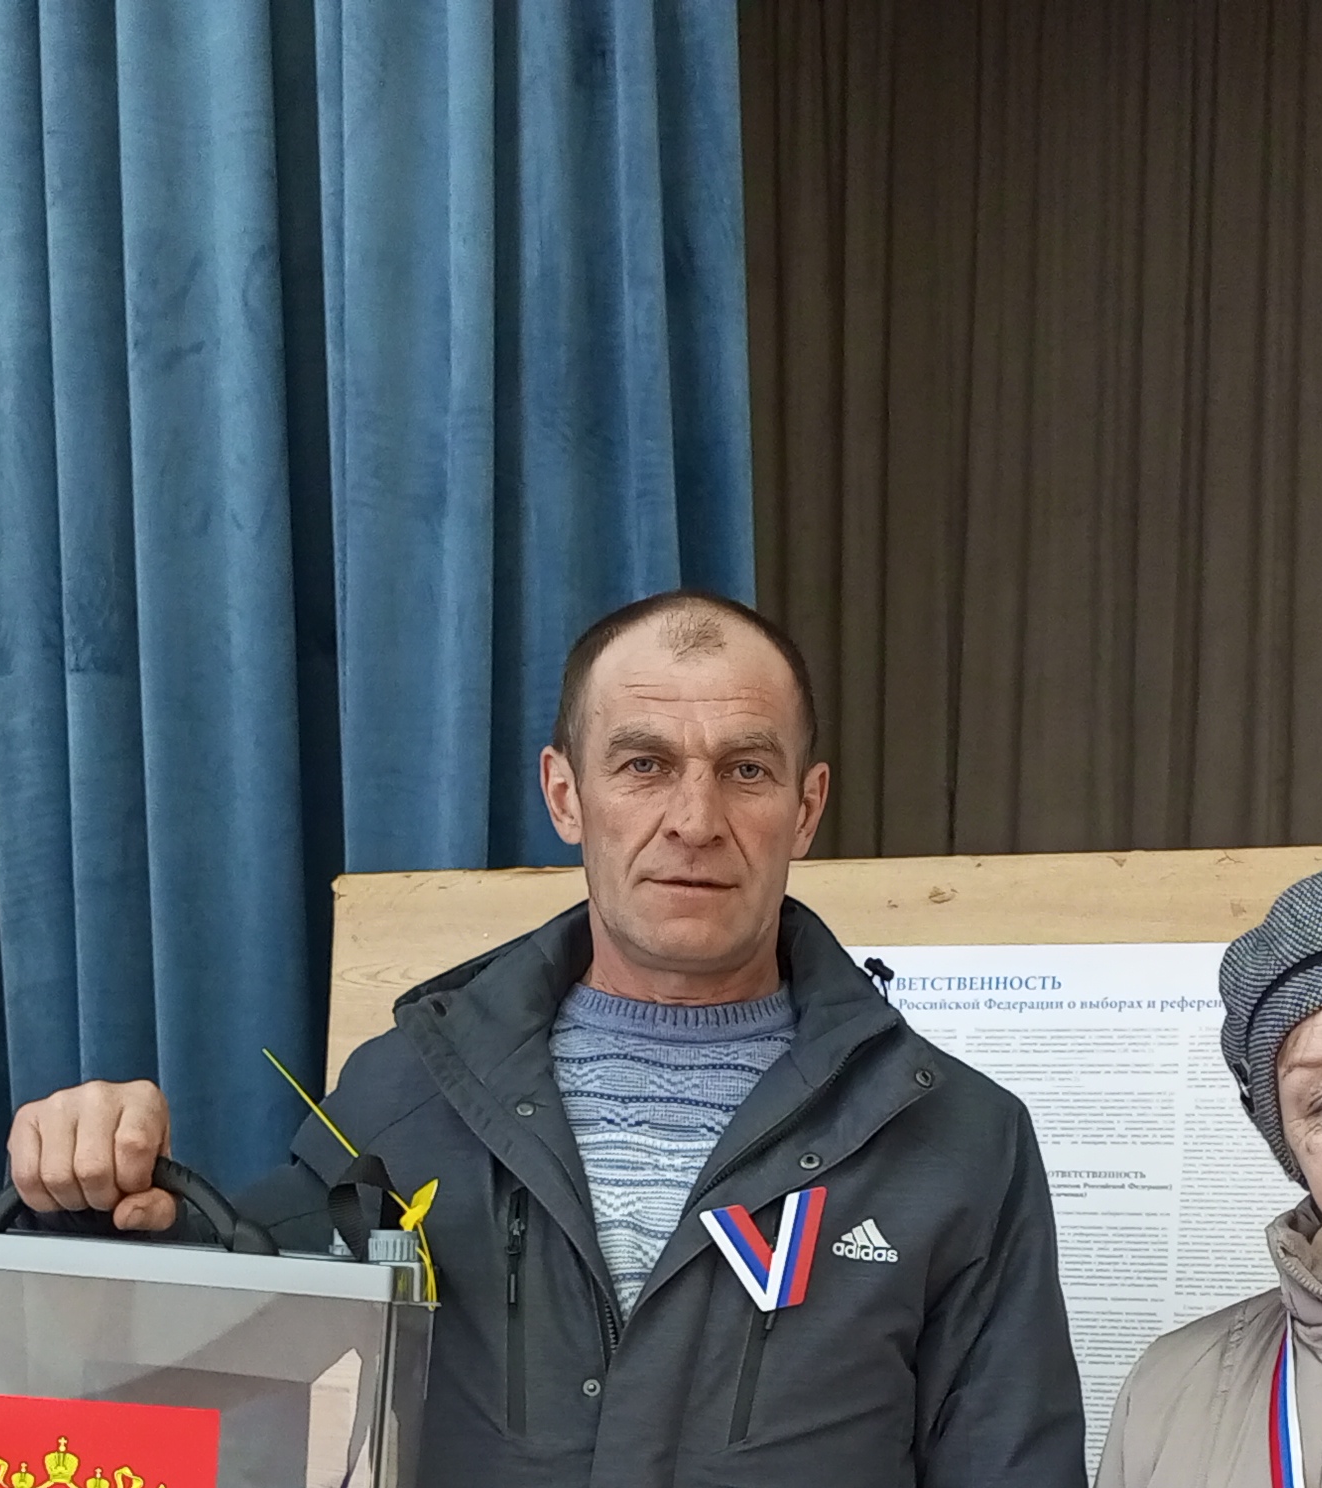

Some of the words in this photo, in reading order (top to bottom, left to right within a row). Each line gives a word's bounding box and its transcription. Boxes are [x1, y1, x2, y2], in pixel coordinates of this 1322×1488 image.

[899, 998, 980, 1010] Российской
[984, 998, 1063, 1013] Федерации
[1067, 1000, 1076, 1009] о
[1080, 997, 1142, 1012] выборах
[1147, 1000, 1156, 1009] и
[832, 1241, 898, 1263] adidas
